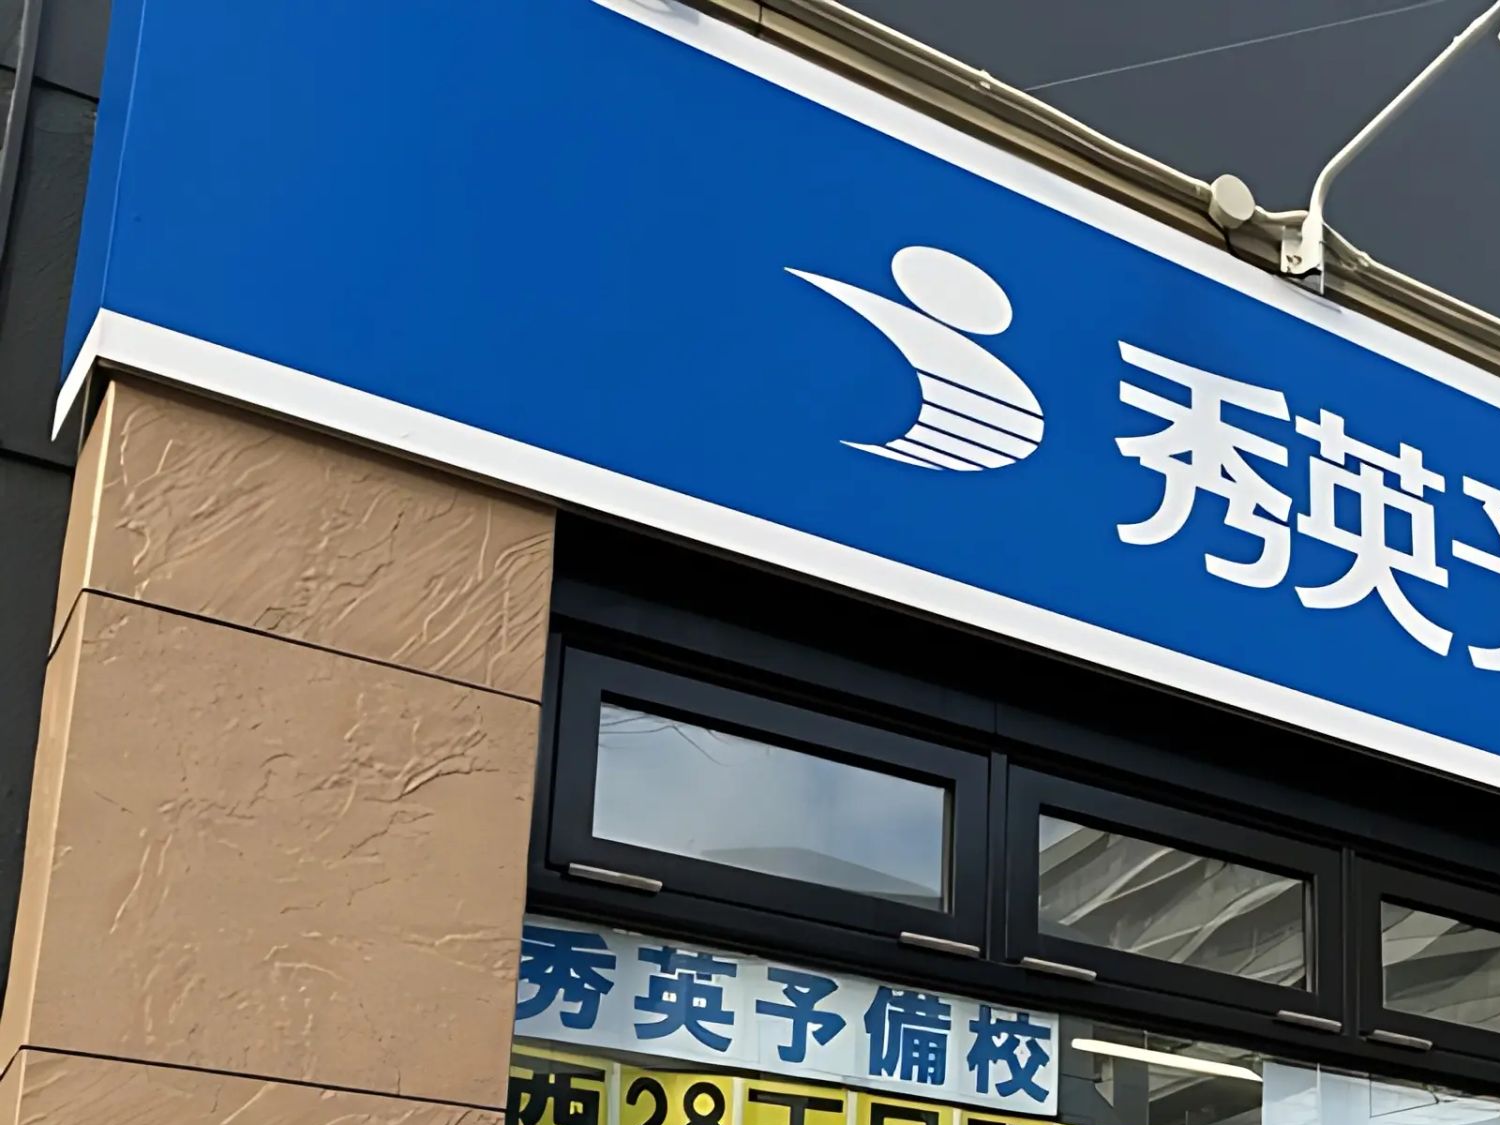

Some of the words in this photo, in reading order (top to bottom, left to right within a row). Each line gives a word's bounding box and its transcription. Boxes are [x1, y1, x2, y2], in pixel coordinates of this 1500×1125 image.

[515, 923, 1052, 1103] 秀英予備校
